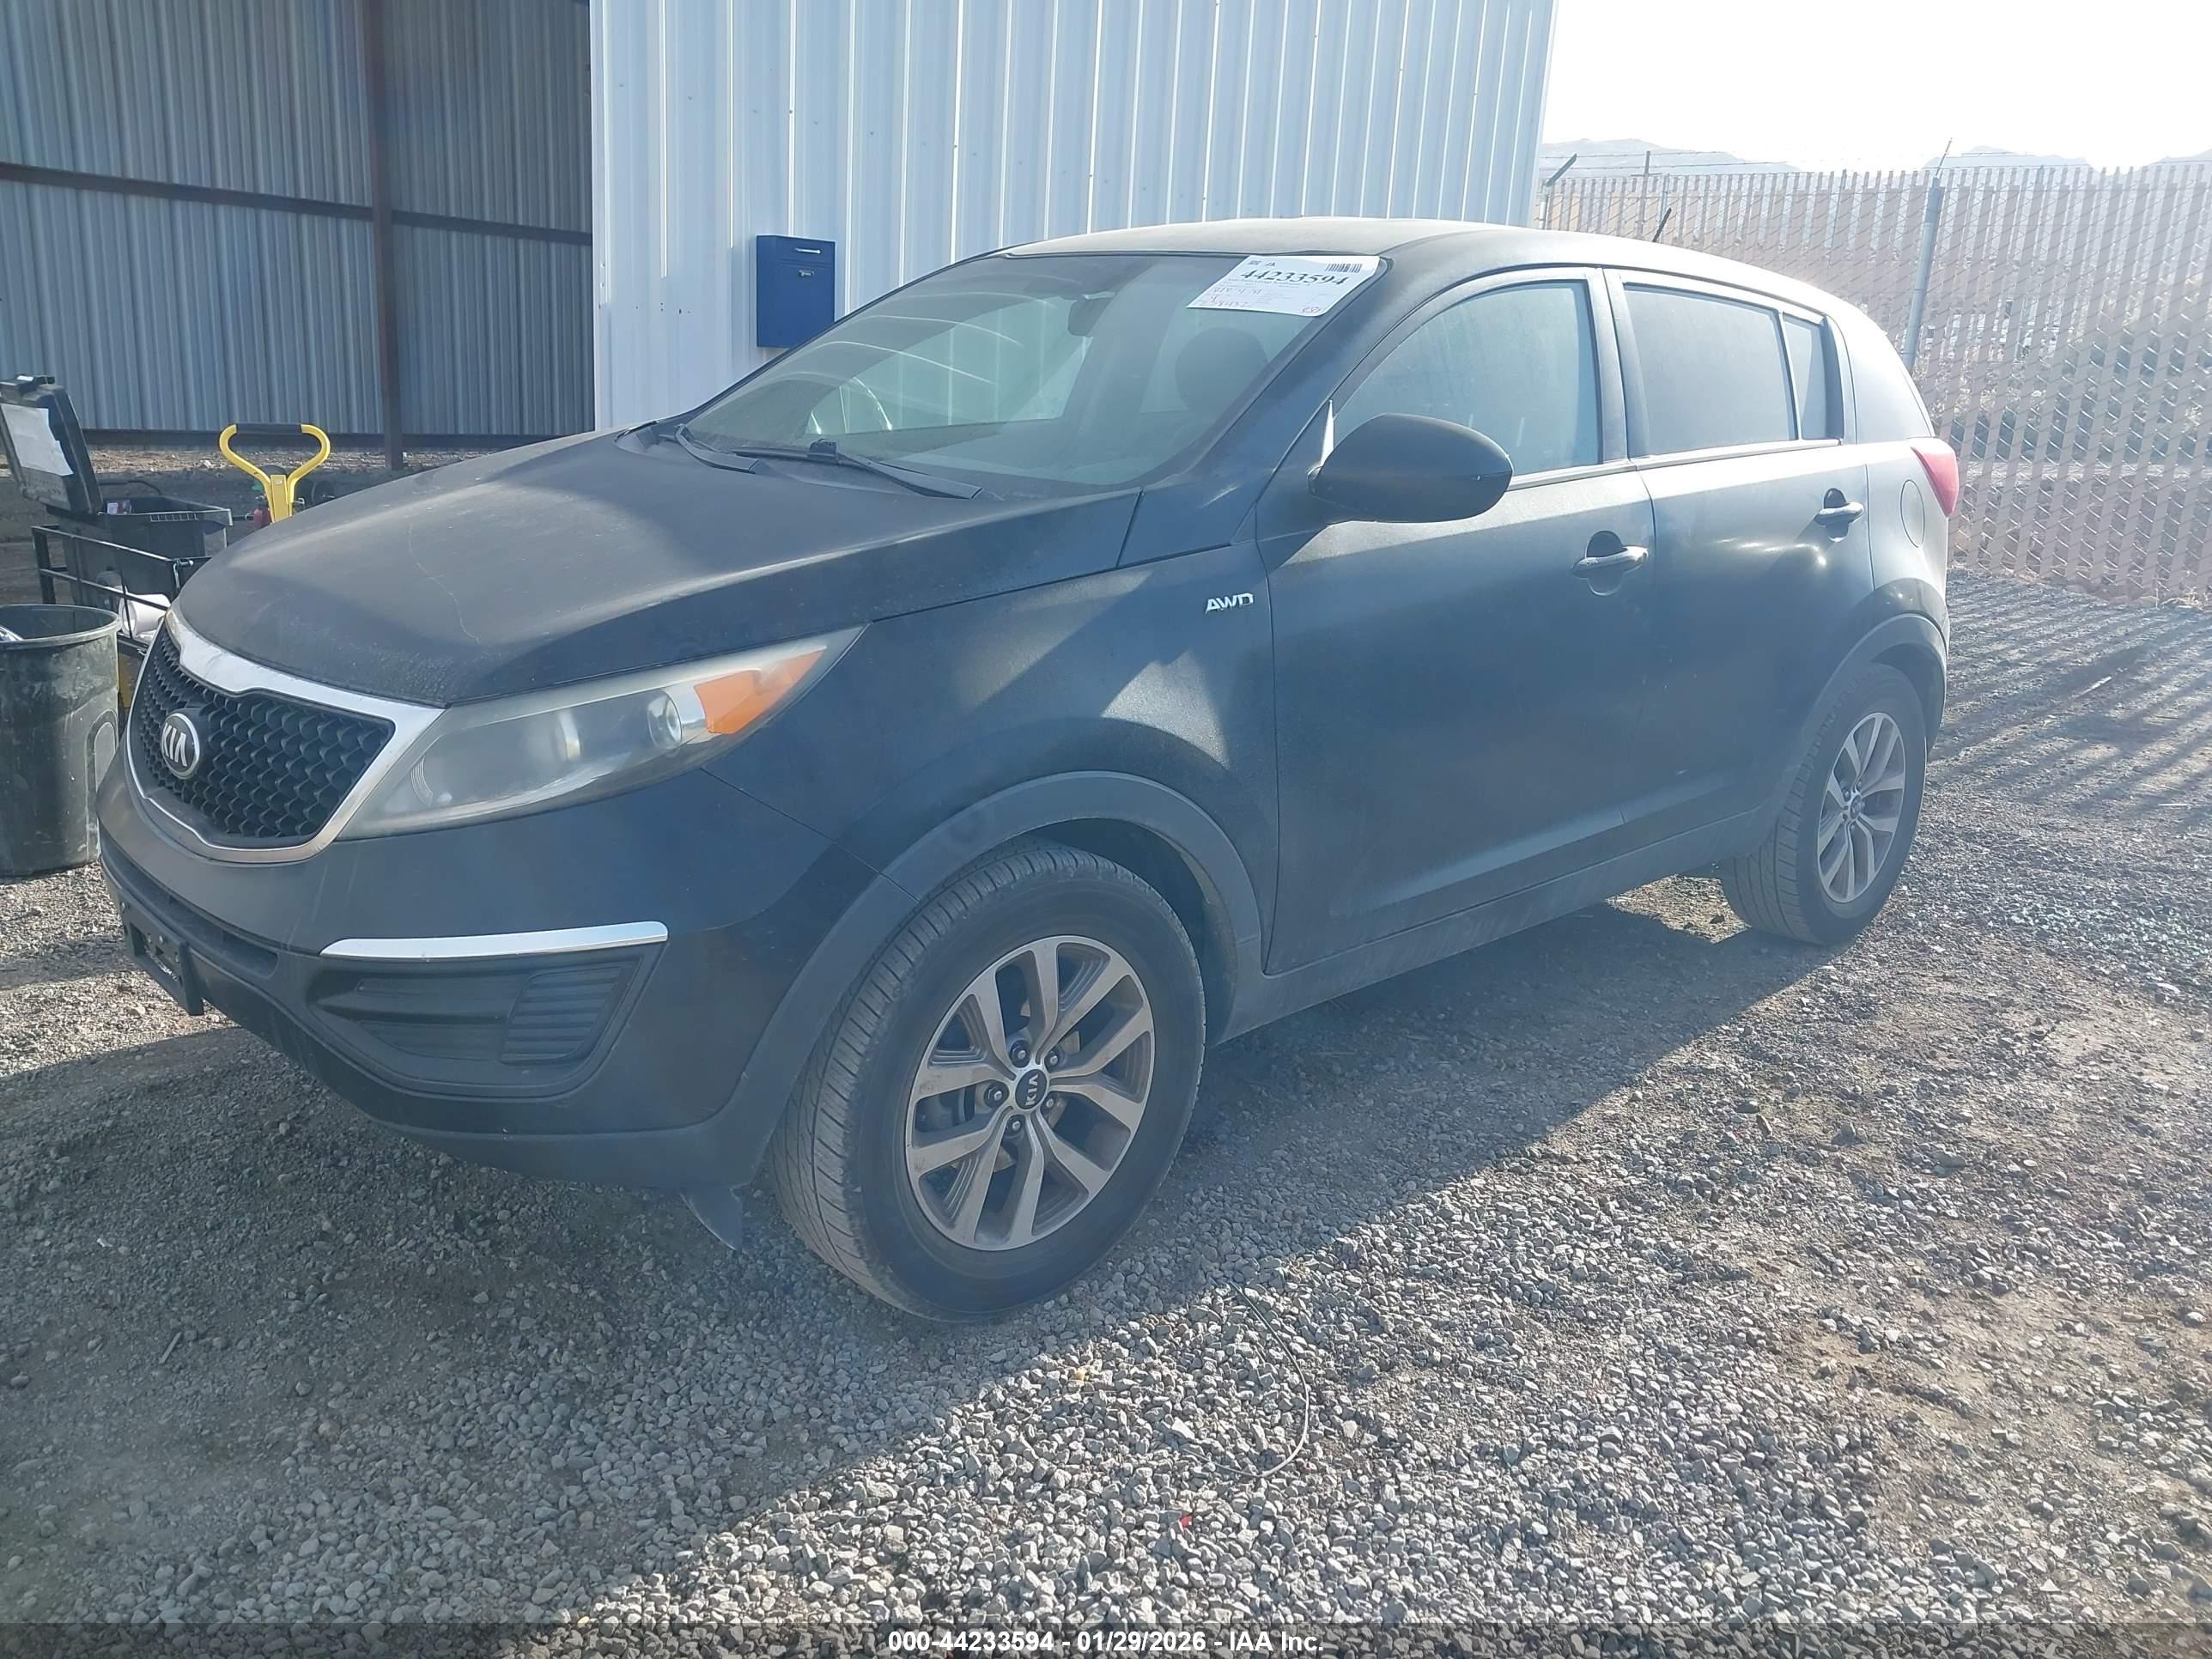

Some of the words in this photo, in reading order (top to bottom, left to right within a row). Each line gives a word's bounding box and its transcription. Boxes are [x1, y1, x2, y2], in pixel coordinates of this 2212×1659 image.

[1241, 270, 1349, 284] 44233594
[1206, 592, 1254, 614] AWD
[161, 722, 187, 767] KIA
[1025, 1073, 1039, 1106] KIA
